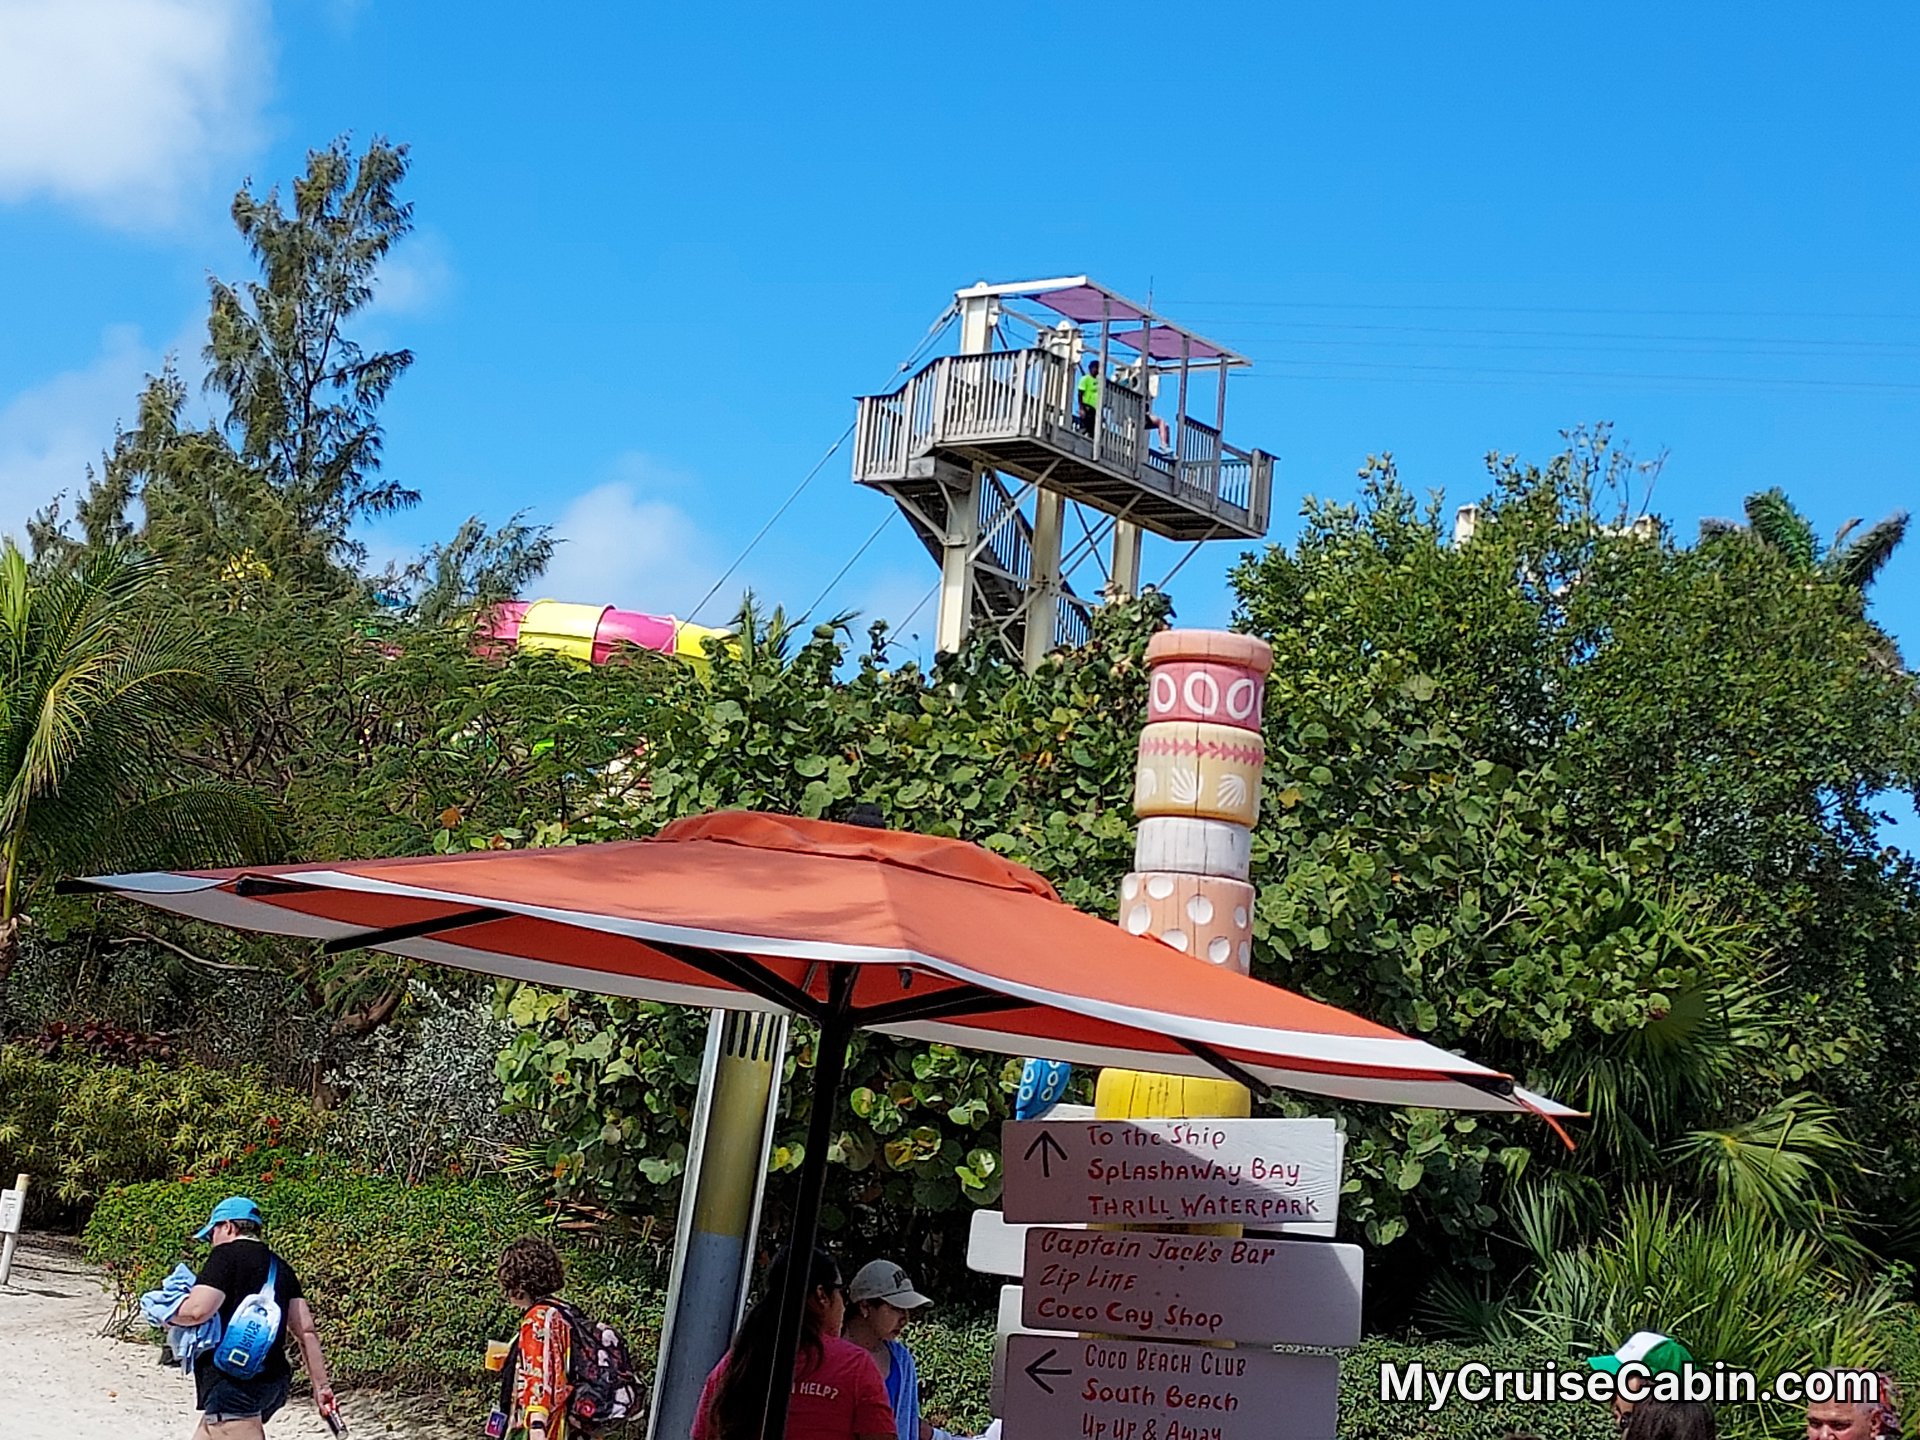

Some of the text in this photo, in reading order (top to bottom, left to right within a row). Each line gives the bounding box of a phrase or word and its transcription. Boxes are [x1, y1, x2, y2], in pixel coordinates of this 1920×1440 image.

[1087, 1125, 1226, 1150] To the Ship
[1087, 1195, 1170, 1218] THRILL
[1041, 1231, 1276, 1265] Captain Jack's Bar
[1039, 1263, 1080, 1295] Zip
[1037, 1297, 1098, 1320] Coco
[1163, 1304, 1224, 1333] Shop
[1136, 1347, 1192, 1374] BEACH
[1201, 1351, 1247, 1377] CLUB
[799, 1381, 839, 1400] HELP?
[1081, 1377, 1156, 1406] South
[1141, 1418, 1158, 1440] &
